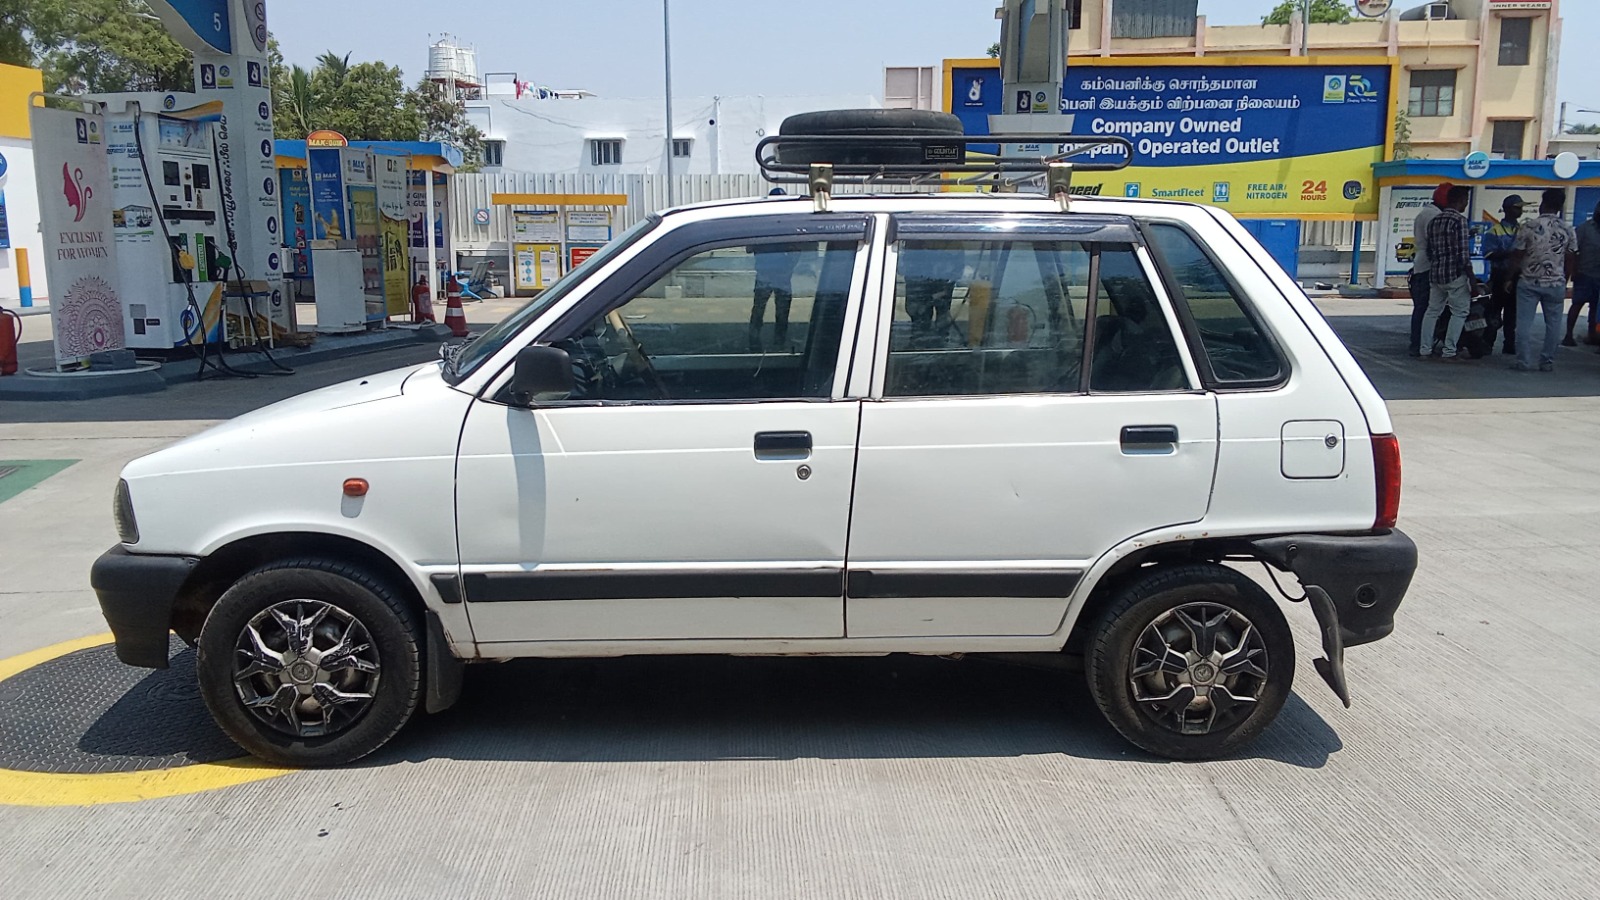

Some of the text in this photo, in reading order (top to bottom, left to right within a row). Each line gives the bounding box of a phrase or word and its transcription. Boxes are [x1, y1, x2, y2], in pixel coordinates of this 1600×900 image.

[213, 12, 222, 32] 5
[1080, 75, 1258, 93] கம்பெனிக்கு சொந்தமான
[1099, 96, 1164, 111] இயக்கும்
[1166, 95, 1234, 113] விற்பனை
[1235, 94, 1301, 112] நிலையம்
[1091, 117, 1242, 137] Company Owned
[1138, 138, 1230, 157] Operated
[1231, 137, 1280, 154] Outlet
[1151, 188, 1205, 198] SmartFleet
[1247, 184, 1268, 192] FREE
[1301, 180, 1328, 194] 24
[1246, 191, 1288, 200] NITROGEN
[59, 231, 104, 244] EXCLUSIVE
[57, 246, 108, 261] FOR WOMEN
